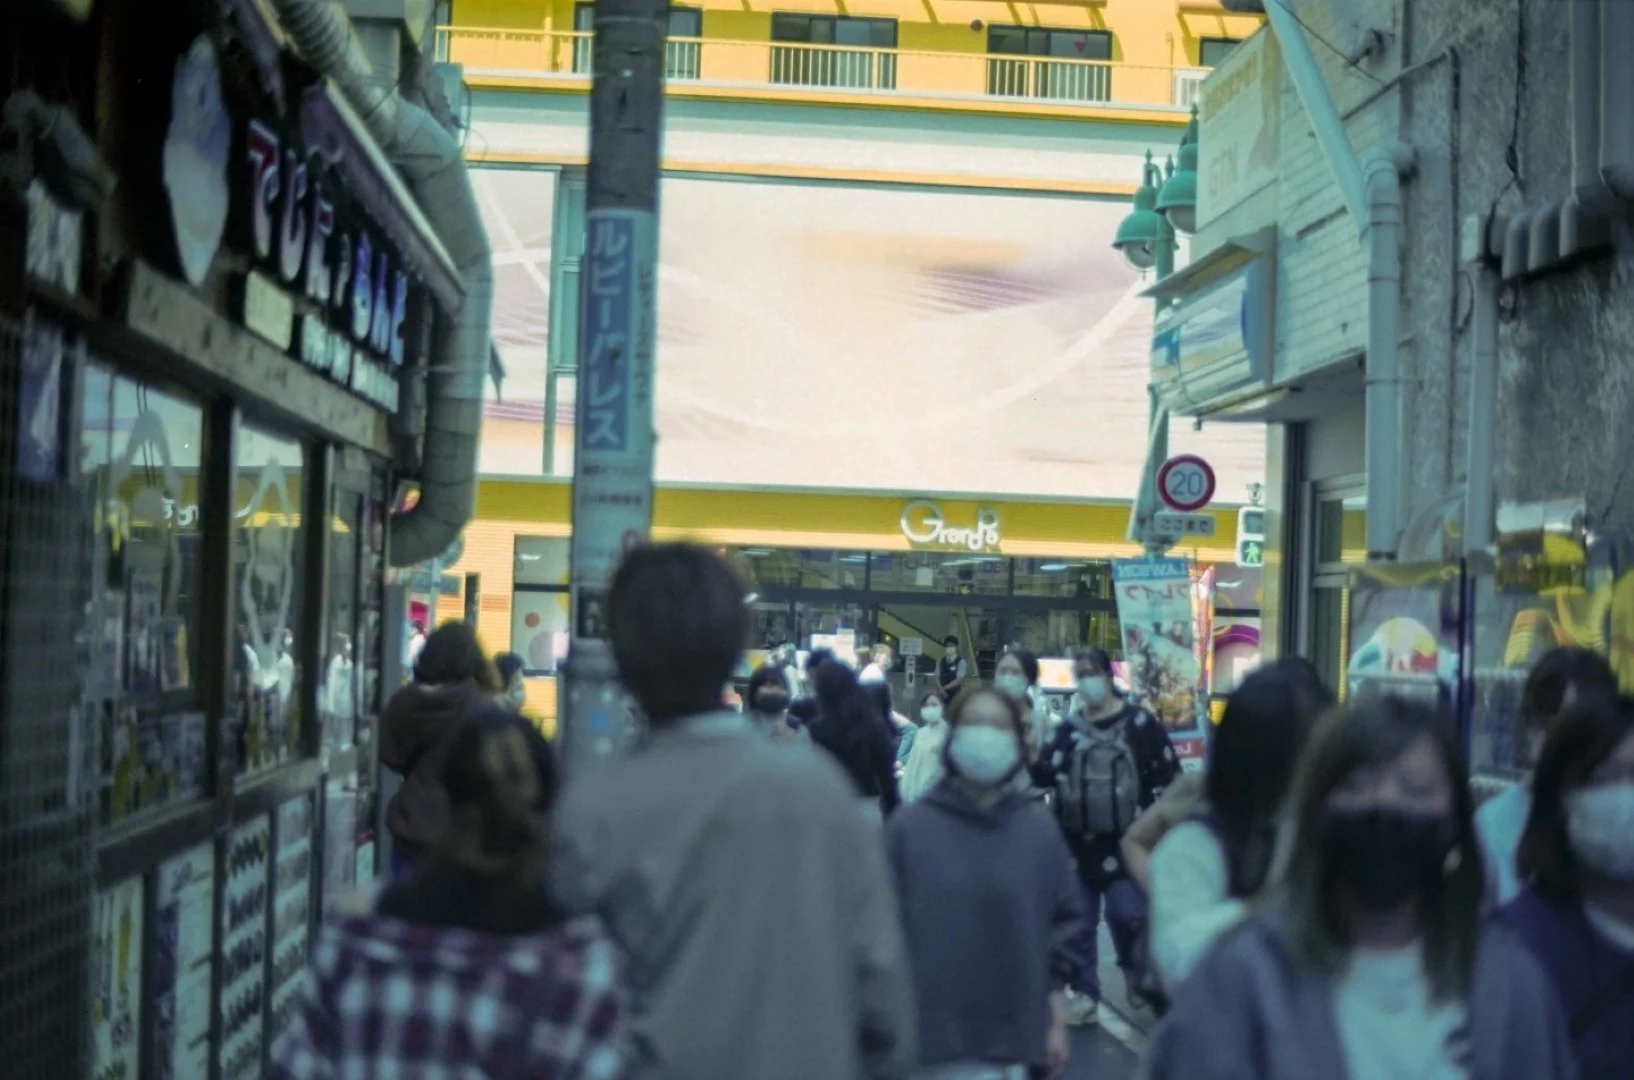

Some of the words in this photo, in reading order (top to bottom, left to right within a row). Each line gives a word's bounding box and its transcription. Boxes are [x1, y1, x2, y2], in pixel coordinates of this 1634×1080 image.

[1170, 469, 1203, 497] 20
[1160, 518, 1209, 533] ここまで
